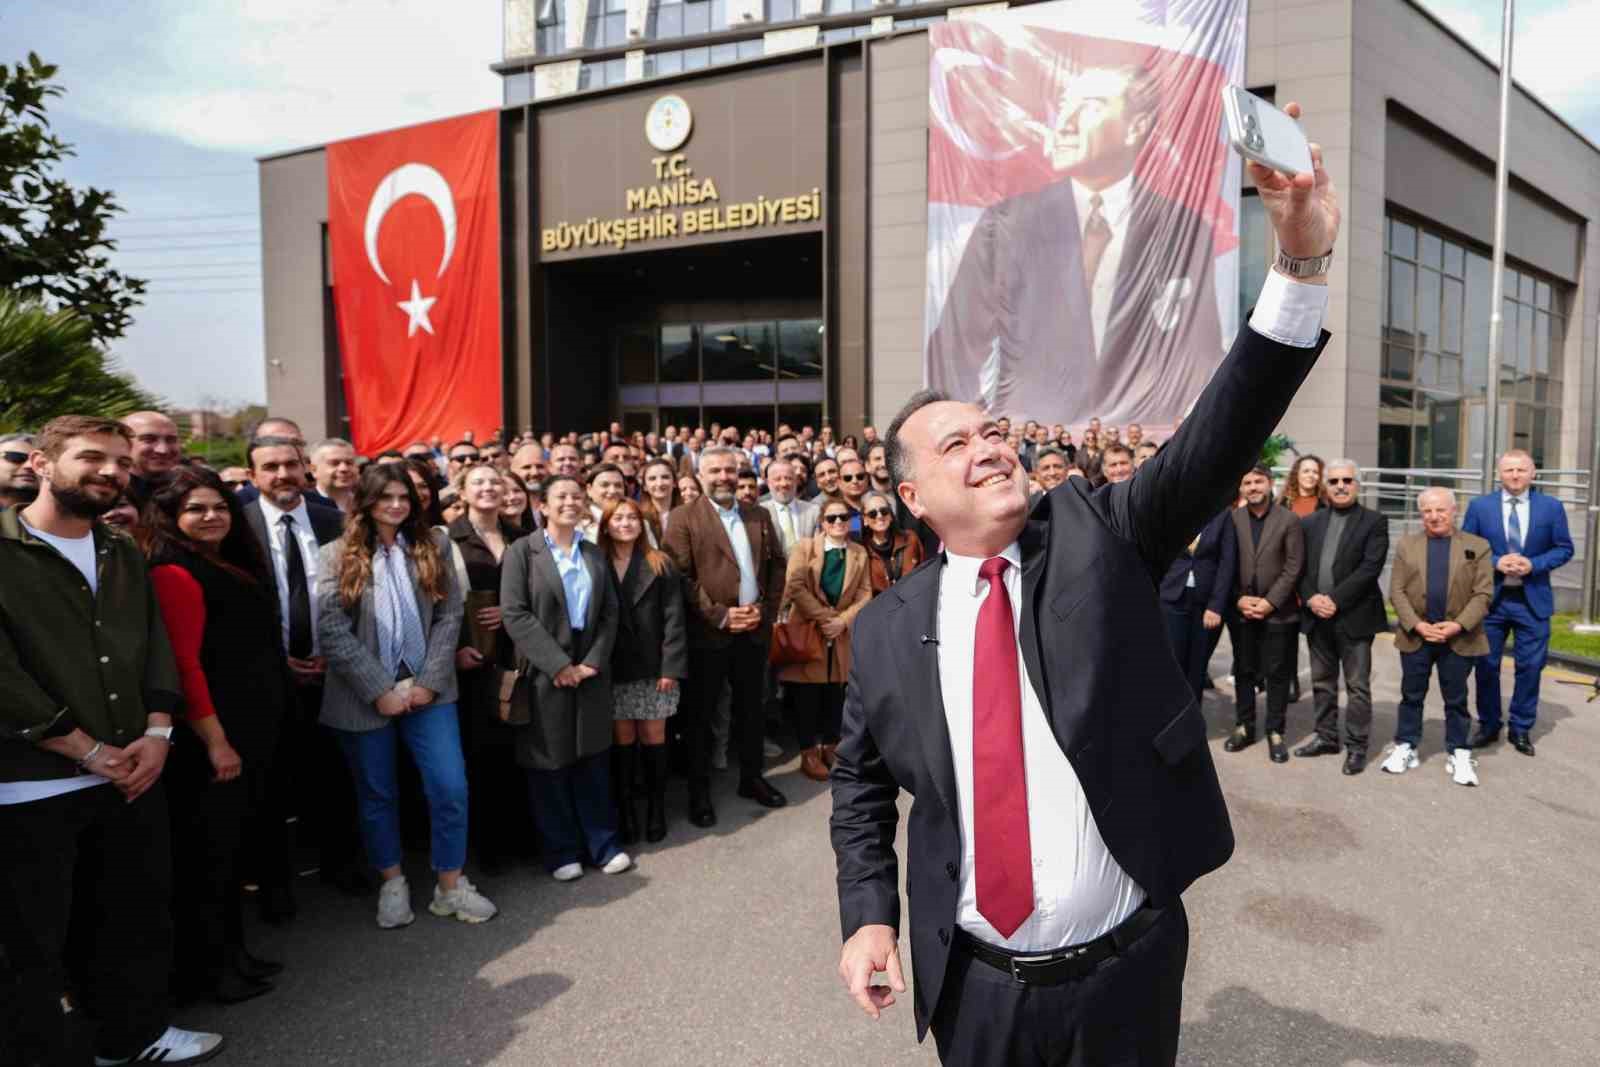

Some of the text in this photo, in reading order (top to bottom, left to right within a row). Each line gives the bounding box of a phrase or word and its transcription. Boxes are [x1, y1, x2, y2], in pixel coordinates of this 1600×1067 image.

[652, 154, 692, 178] T.C.
[626, 178, 718, 210] MANİSA
[541, 187, 820, 250] BÜYÜKŞEHİR BELEDİYESİ
